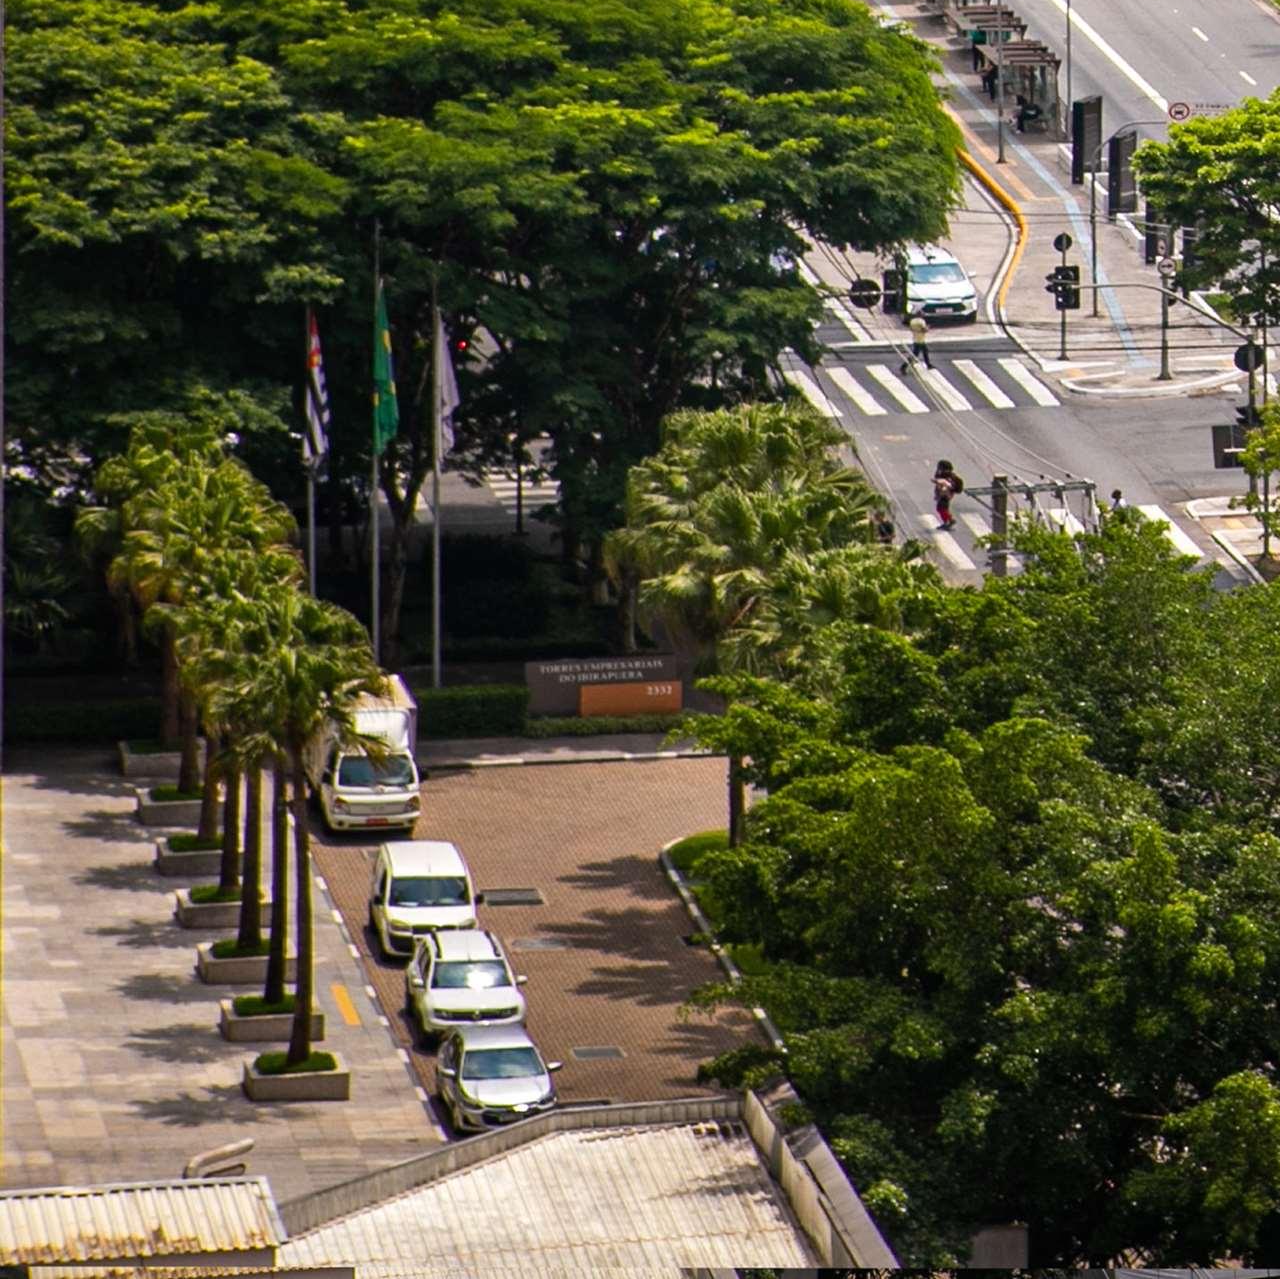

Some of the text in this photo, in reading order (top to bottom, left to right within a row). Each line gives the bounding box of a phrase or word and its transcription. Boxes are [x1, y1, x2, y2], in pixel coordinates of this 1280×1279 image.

[540, 659, 663, 674] TORRES EMPRESARIAIS
[559, 671, 643, 682] DO IBIRAPUERA
